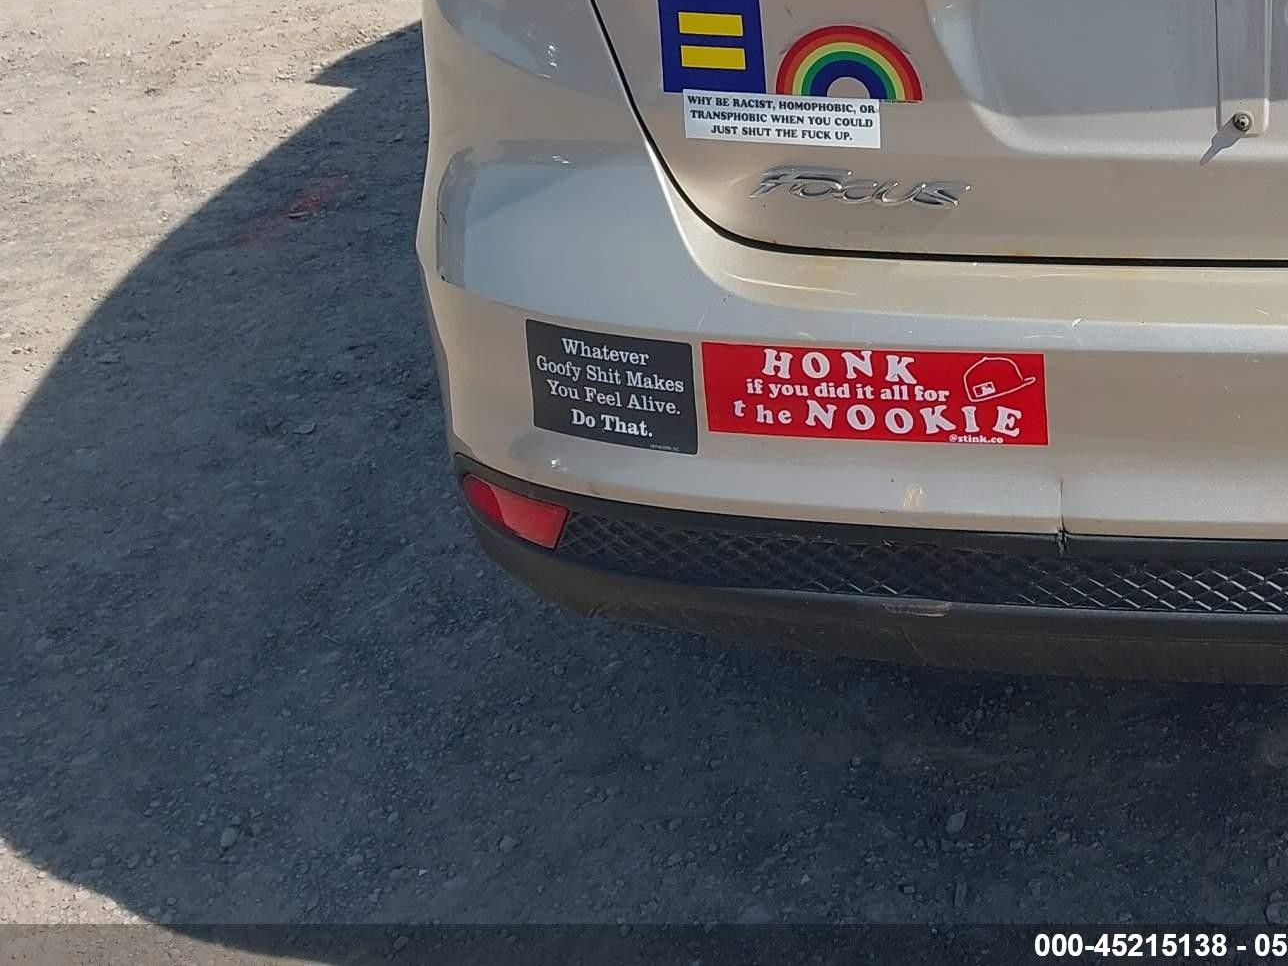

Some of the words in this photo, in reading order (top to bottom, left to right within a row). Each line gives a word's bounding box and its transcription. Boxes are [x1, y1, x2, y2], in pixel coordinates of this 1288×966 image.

[688, 95, 712, 106] WHY
[715, 97, 730, 107] BE
[732, 98, 776, 111] RACIST,
[778, 101, 857, 115] HOMOPHOBIC,
[859, 104, 876, 114] OR
[690, 110, 767, 123] TRANSPHOBIC
[771, 114, 805, 125] WHEN
[807, 116, 831, 126] YOU
[834, 117, 873, 128] COULD
[711, 125, 739, 135] JUST
[741, 126, 771, 137] SHUT
[775, 128, 799, 138] THE
[801, 130, 832, 140] FUCK
[835, 131, 853, 141] UP.
[561, 337, 650, 366] Whatever
[536, 354, 581, 382] Goofy
[586, 364, 622, 385] Shit
[626, 370, 685, 393] Makes
[761, 348, 917, 385] HONK
[546, 379, 581, 400] You
[583, 386, 622, 408] Feel
[627, 394, 681, 415] Alive.
[745, 378, 763, 395] if
[768, 383, 809, 399] you
[814, 382, 850, 399] did
[855, 383, 875, 399] it
[879, 384, 910, 401] all
[914, 385, 950, 402] for
[571, 408, 596, 428] Do
[600, 414, 654, 438] That.
[805, 399, 1023, 437] NOOKIE
[948, 433, 1004, 444] @stink.co
